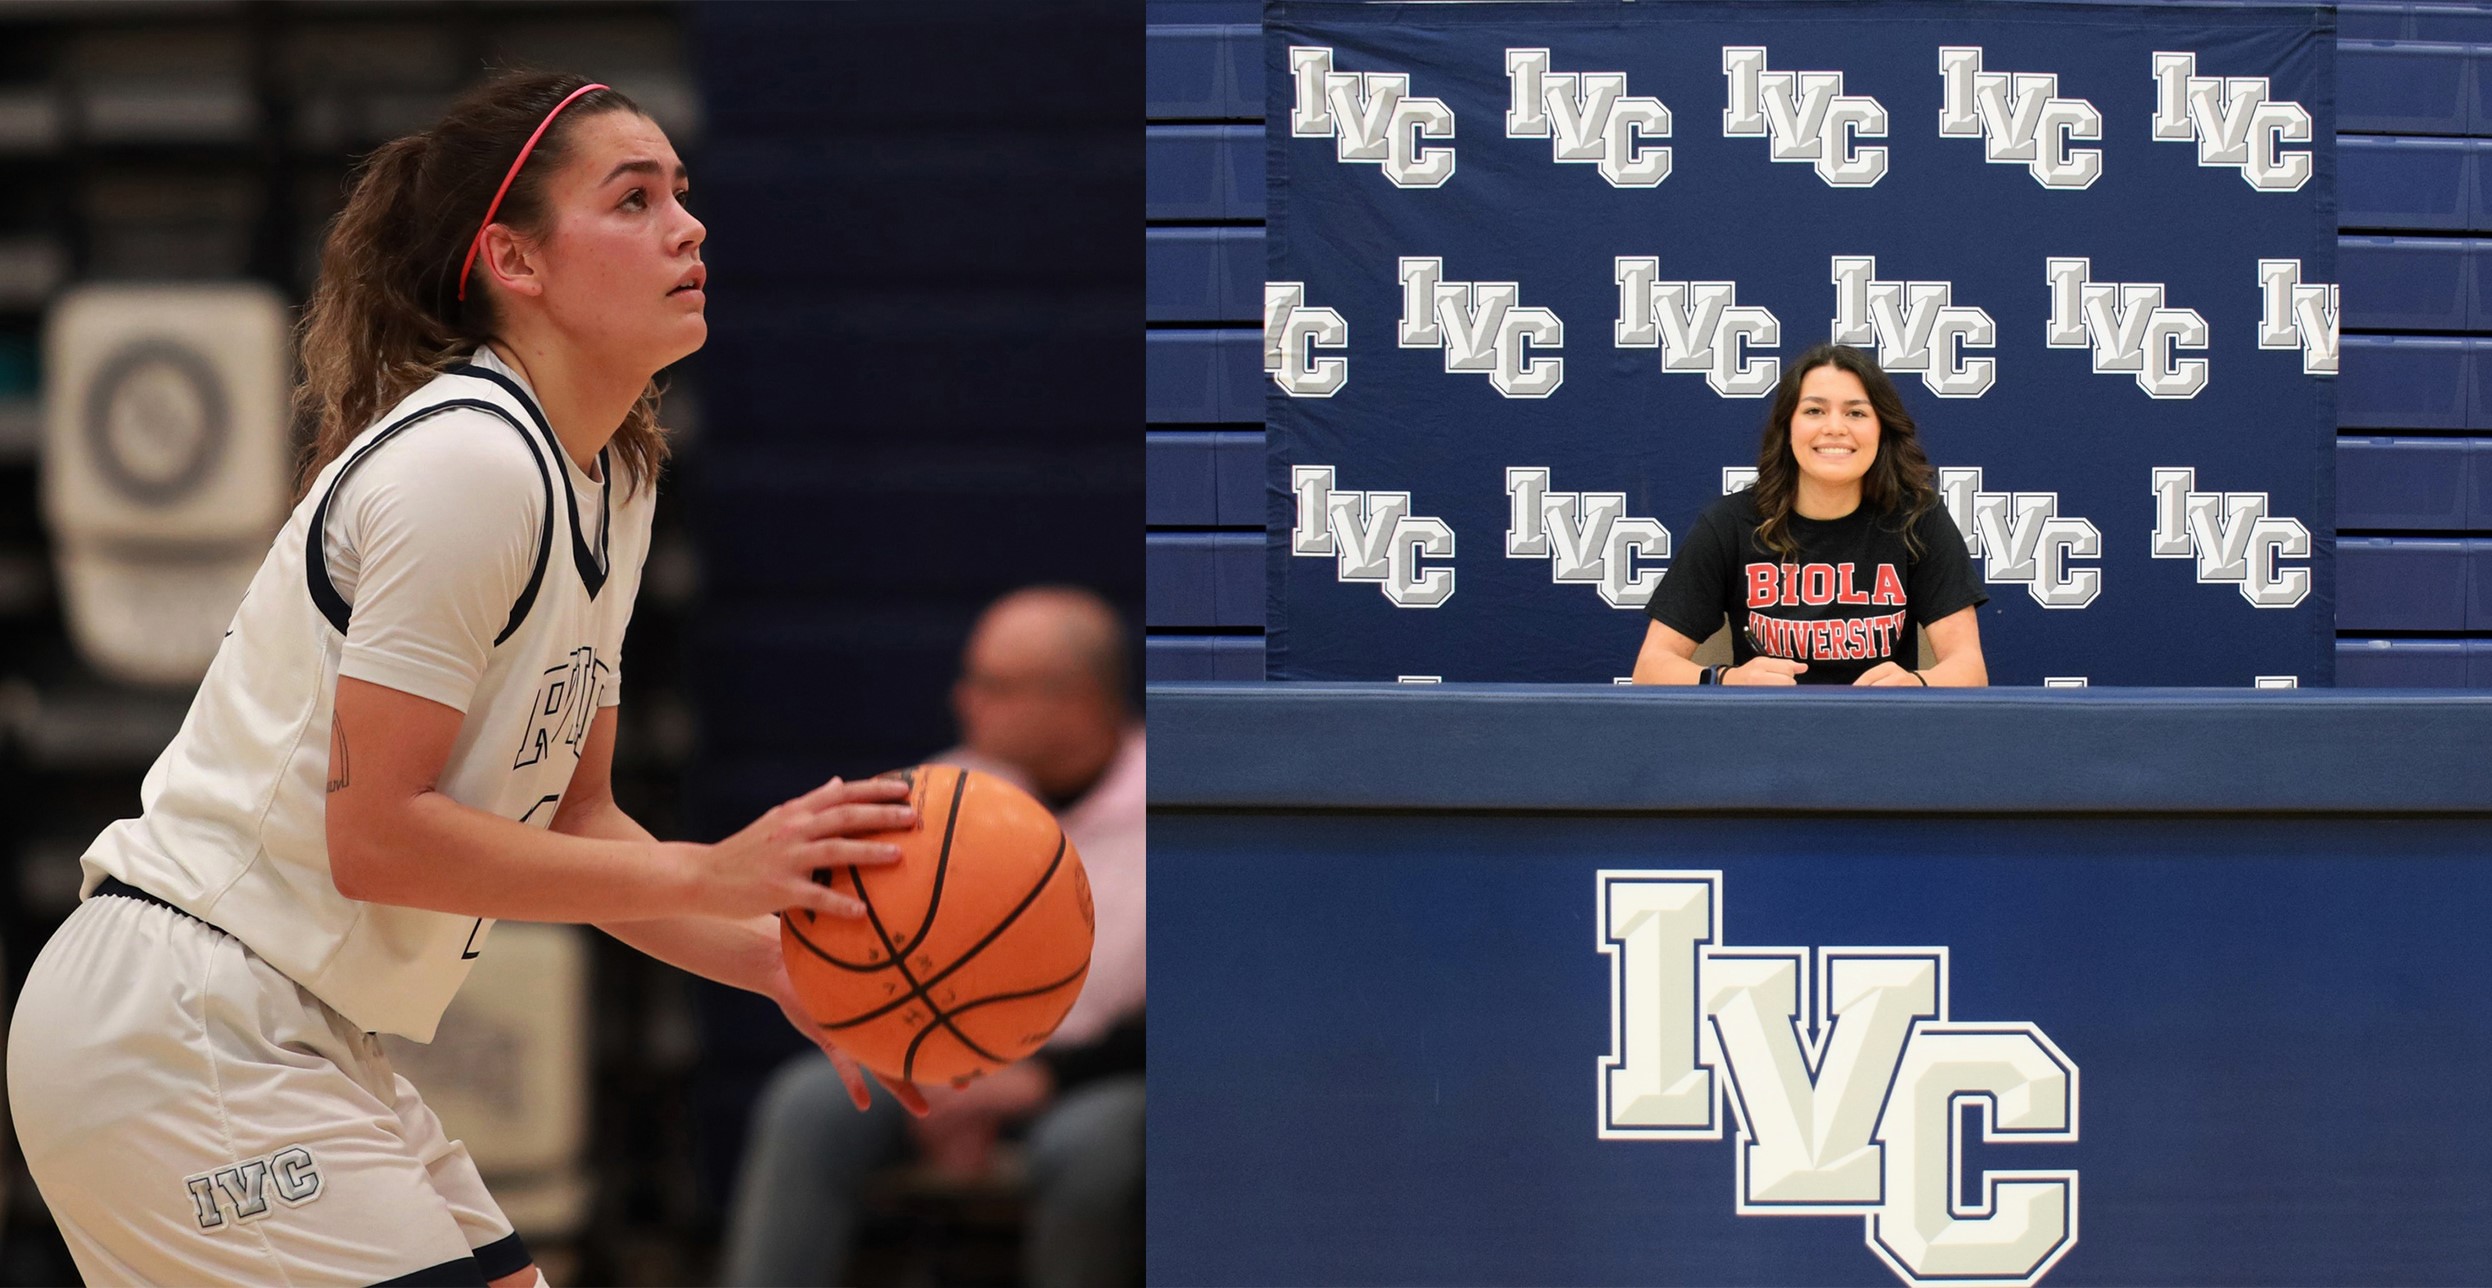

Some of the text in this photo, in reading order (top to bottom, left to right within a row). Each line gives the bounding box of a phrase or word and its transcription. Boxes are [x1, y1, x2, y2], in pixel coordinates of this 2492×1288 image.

[1290, 46, 1455, 188] IVC
[1506, 48, 1672, 188] IVC
[1723, 46, 1888, 187] IVC
[1939, 46, 2102, 190] IVC
[2152, 52, 2312, 192] IVC
[1399, 257, 1563, 398] IVC
[1615, 256, 1780, 398] IVC
[1832, 256, 1995, 398] IVC
[2047, 257, 2208, 399] IVC
[1292, 465, 1455, 608] IVC
[1506, 467, 1671, 609] IVC
[1745, 562, 1907, 608] BIOLA
[1939, 467, 2101, 608] IVC
[2152, 467, 2310, 608] IVC
[1749, 609, 1906, 660] UNIVERSITY
[1597, 870, 2079, 1288] IVC
[187, 1147, 320, 1229] IVC
